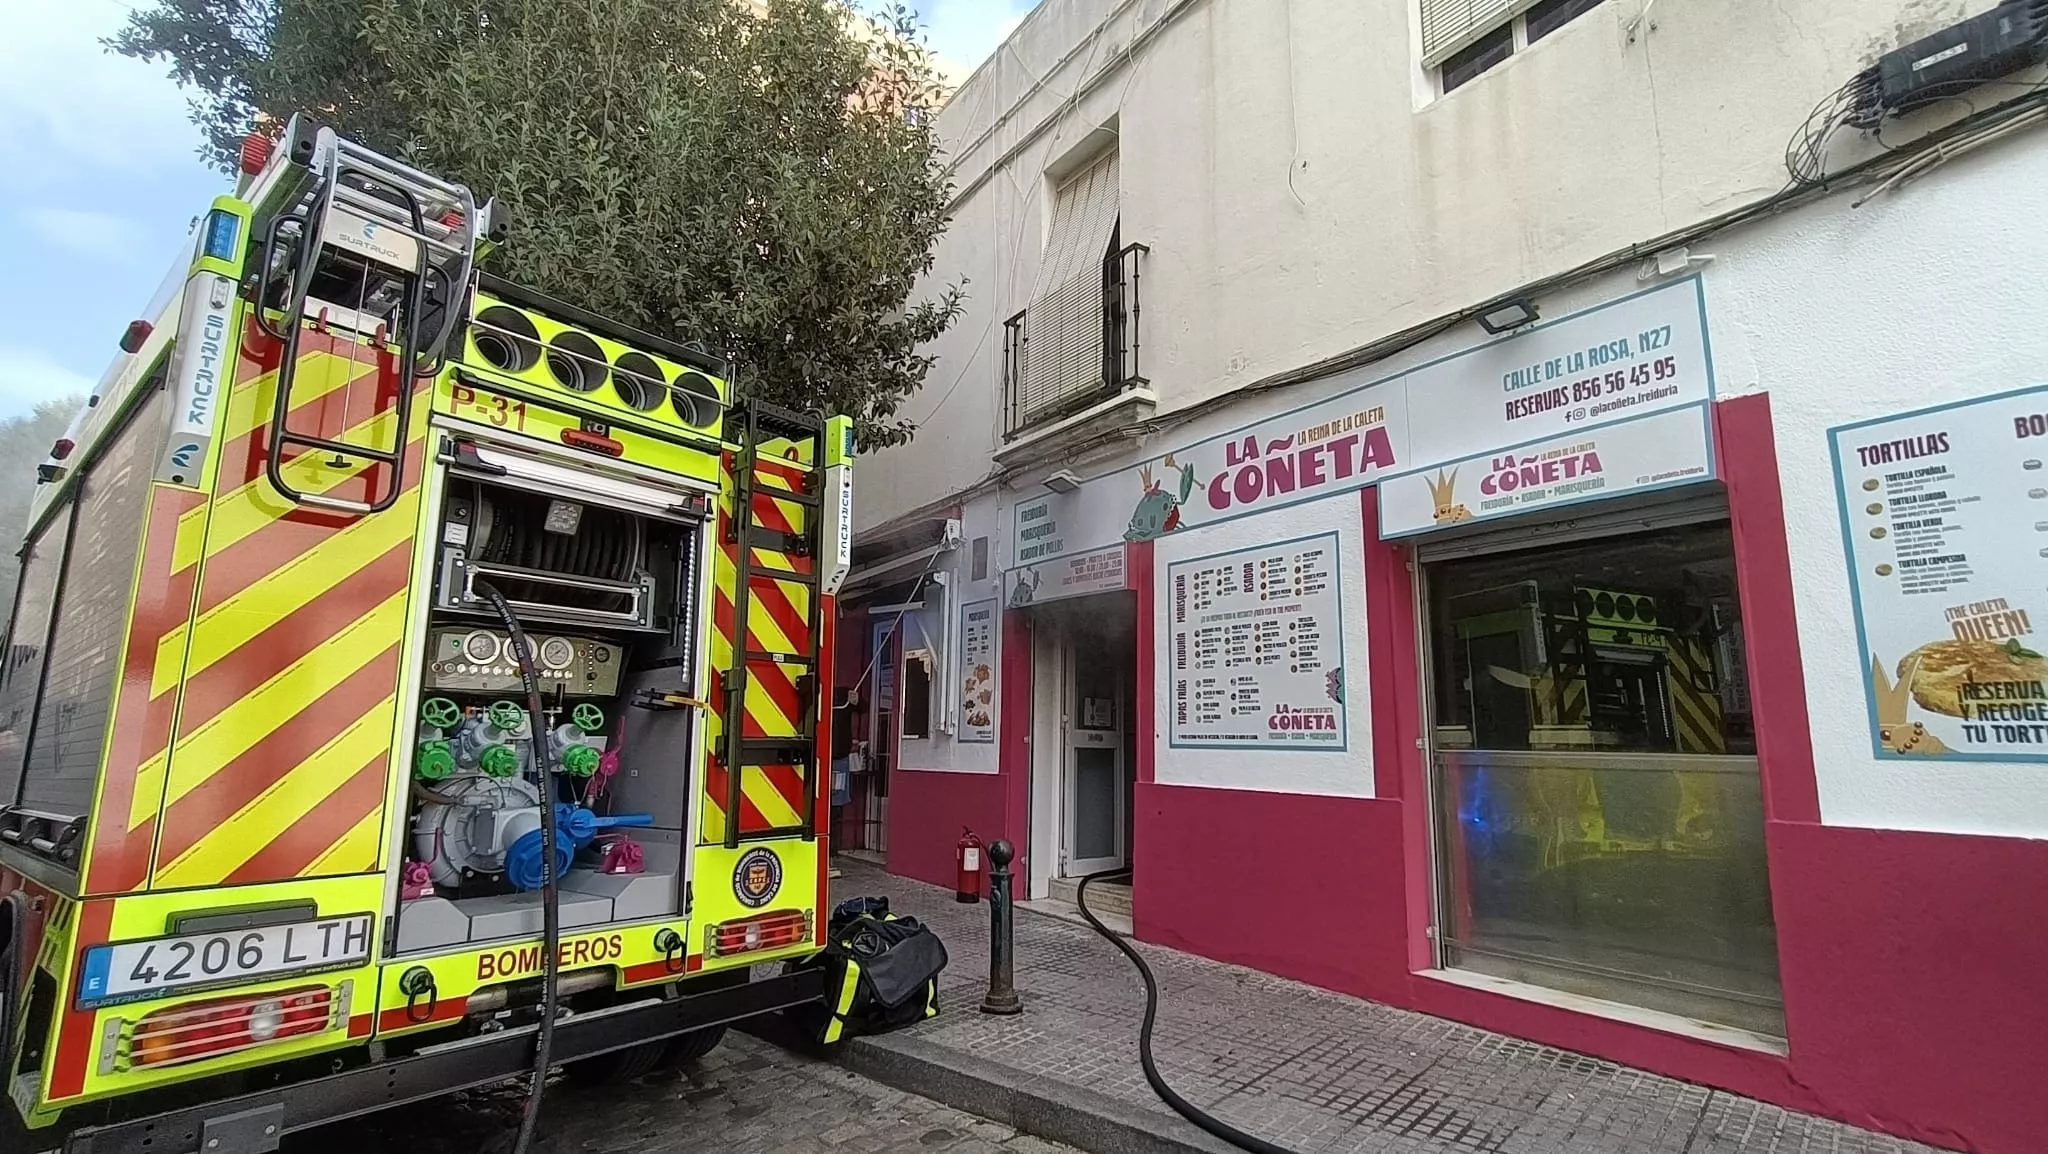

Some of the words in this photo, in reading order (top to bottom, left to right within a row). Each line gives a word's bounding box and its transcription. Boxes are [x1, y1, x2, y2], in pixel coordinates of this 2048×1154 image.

[338, 232, 400, 260] SURTRUCK
[188, 314, 224, 425] SURTRUCK
[1503, 363, 1542, 392] CALLE
[1545, 357, 1564, 381] DE
[1566, 351, 1585, 374] LA
[1588, 338, 1635, 368] ROSA,
[1638, 324, 1672, 353] N27
[1505, 385, 1570, 421] RESERVAS
[1572, 376, 1601, 403] 856
[1604, 370, 1626, 394] 56
[1629, 363, 1650, 387] 45
[1654, 355, 1676, 381] 95
[450, 384, 526, 432] P-31
[1226, 434, 1260, 467] LA
[1298, 430, 1307, 446] LA
[1308, 422, 1330, 443] REINA
[1332, 420, 1342, 436] DE
[1343, 416, 1353, 431] LA
[1354, 406, 1384, 429] CALETA
[1856, 432, 1950, 468] TORTILLAS
[1492, 454, 1516, 472] LA
[840, 490, 849, 558] SURTRUCK
[1244, 562, 1254, 593] ASADOR
[1175, 574, 1188, 623] MARISQUERÍA
[1968, 598, 2008, 616] CALETA
[1952, 609, 2033, 642] QUEEN!
[1176, 632, 1187, 670] FREIDURÍA
[1176, 680, 1187, 700] FRÍAS
[1958, 680, 2045, 704] ¡RESERVA
[1178, 701, 1187, 726] TAPAS
[1276, 704, 1290, 714] LA
[1958, 704, 1970, 722] Y
[1961, 725, 1988, 744] TU
[1990, 725, 2048, 744] TORT
[129, 932, 263, 984] 4206
[282, 918, 369, 963] LTH
[88, 976, 100, 990] E
